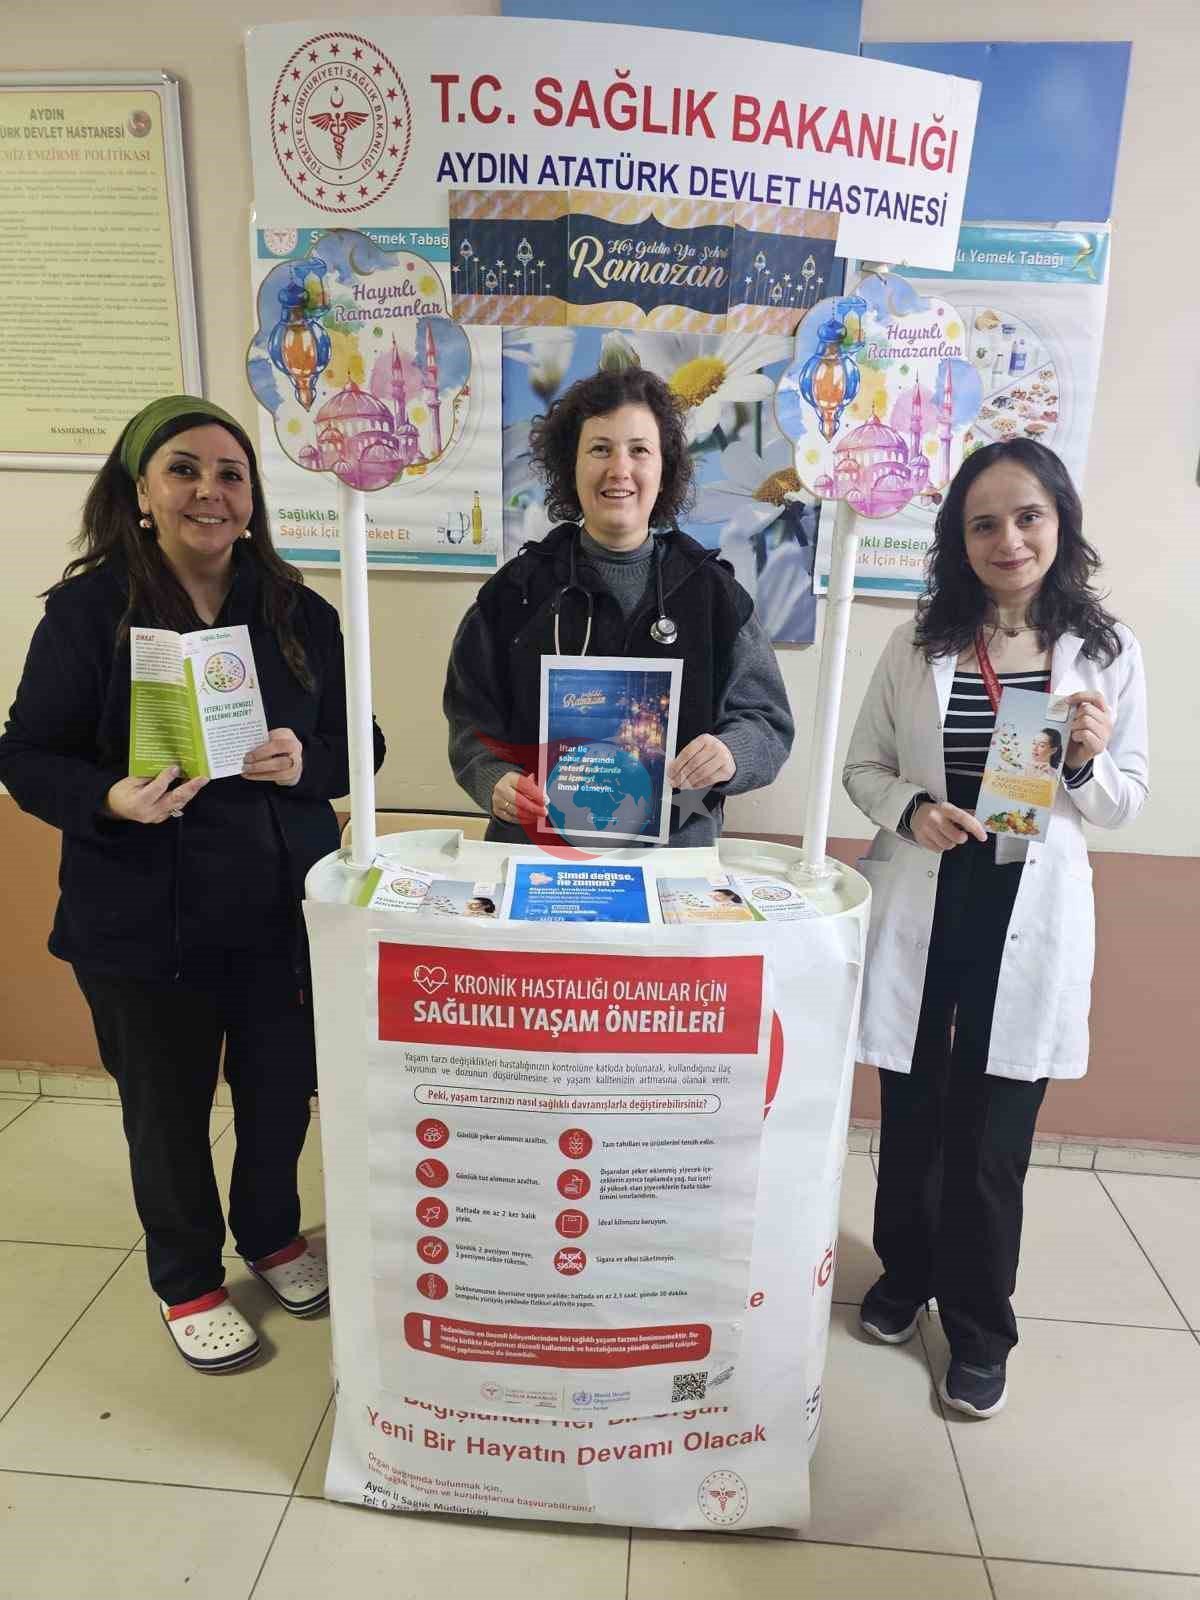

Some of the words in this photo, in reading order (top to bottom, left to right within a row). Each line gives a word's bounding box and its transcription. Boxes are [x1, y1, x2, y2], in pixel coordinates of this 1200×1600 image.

[295, 66, 343, 124] CUMHURİYETİ
[346, 69, 378, 103] SAĞLIK
[30, 108, 64, 120] AYDIN
[431, 74, 515, 124] T.C.
[534, 68, 718, 139] SAĞLIK
[732, 94, 958, 173] BAKANLIĞI
[24, 126, 63, 138] DEVLET
[66, 124, 124, 138] HASTANESİ
[361, 105, 385, 170] BAKANLIĞI
[84, 148, 151, 161] POLİTİKASI
[437, 152, 528, 184] AYDIN
[537, 152, 680, 194] ATATÜRK
[689, 166, 800, 205] DEVLET
[808, 181, 948, 227] HASTANESİ
[569, 235, 728, 289] Ramazan
[673, 243, 696, 262] Ya
[970, 248, 1015, 264] Yemek
[1019, 250, 1064, 268] Tabağı
[352, 279, 416, 303] Hayırlı
[335, 300, 442, 322] Ramazanlar
[887, 323, 943, 346] Hayırlı
[867, 342, 962, 360] Ramazanlar
[278, 508, 325, 523] Sağlıklı
[280, 525, 318, 540] Sağlık
[398, 528, 410, 540] Et
[874, 551, 896, 566] İçin
[454, 973, 517, 997] KRONİK
[521, 977, 608, 1000] HASTALIĞI
[613, 980, 690, 1002] OLANLAR
[694, 979, 727, 1008] İÇİN
[413, 998, 515, 1029] SAĞLIKLI
[520, 1007, 599, 1038] YAŞAM
[604, 1004, 726, 1034] ÖNERİLERİ
[404, 1052, 429, 1064] Yaşam
[431, 1055, 448, 1064] tarzı
[450, 1056, 498, 1069] değişiklikleri
[500, 1058, 550, 1072] hastalığınızın
[596, 1064, 623, 1074] katkıda
[718, 1064, 732, 1075] ilaç
[456, 1068, 488, 1078] dozunun
[566, 1076, 591, 1086] yaşam
[596, 1076, 635, 1085] kalitenizin
[428, 1089, 449, 1102] Peki,
[450, 1092, 478, 1104] yaşam
[480, 1094, 515, 1105] tarzınızı
[516, 1098, 537, 1108] nasıl
[538, 1098, 570, 1110] sağlıklı
[571, 1099, 628, 1111] davranışlarla
[629, 1099, 708, 1112] değiştirebilirsiniz?
[456, 1206, 480, 1215] Haftada
[596, 1256, 614, 1264] Sigara
[367, 1406, 414, 1442] Yeni
[424, 1429, 456, 1452] Bir
[466, 1436, 566, 1464] Hayatın
[577, 1440, 672, 1466] Devamı
[684, 1423, 767, 1450] Olacak
[365, 1481, 392, 1497] Aydın
[400, 1496, 431, 1509] Sağlık
[410, 1482, 438, 1496] kurum
[454, 1490, 514, 1504] kuruluşlarına
[436, 1478, 480, 1490] bulunmak
[483, 1482, 502, 1493] için,
[362, 1494, 379, 1506] Tel:
